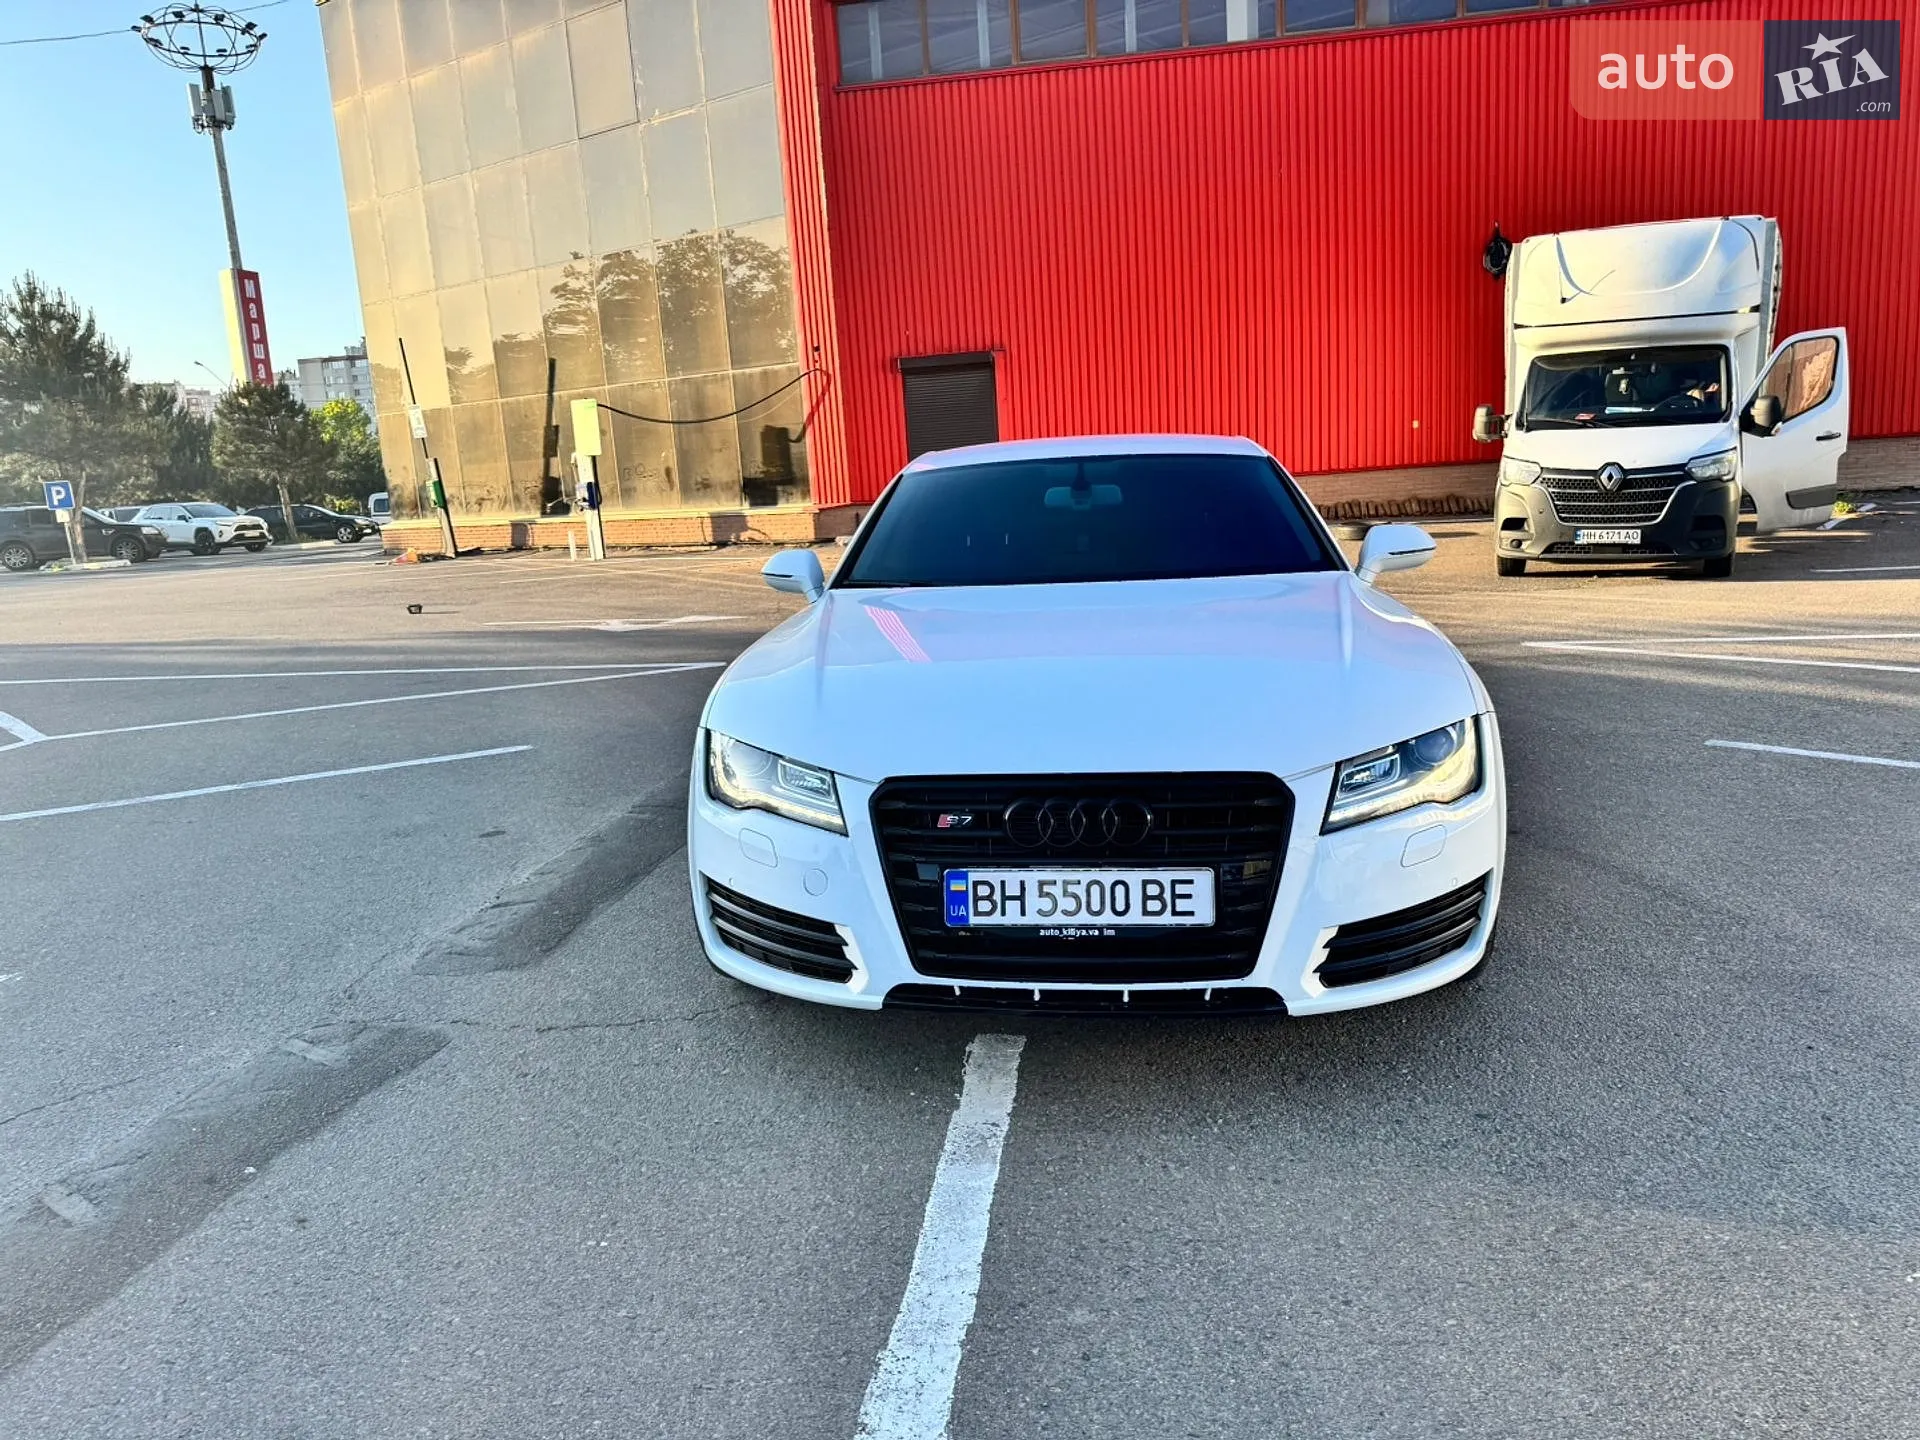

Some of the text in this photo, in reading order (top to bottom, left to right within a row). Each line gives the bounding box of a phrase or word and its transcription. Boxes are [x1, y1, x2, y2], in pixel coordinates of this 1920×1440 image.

[243, 278, 269, 386] Марша
[50, 485, 67, 506] P
[1598, 531, 1622, 540] 6171
[971, 879, 1195, 918] BH 5500 BE
[950, 904, 967, 917] UA
